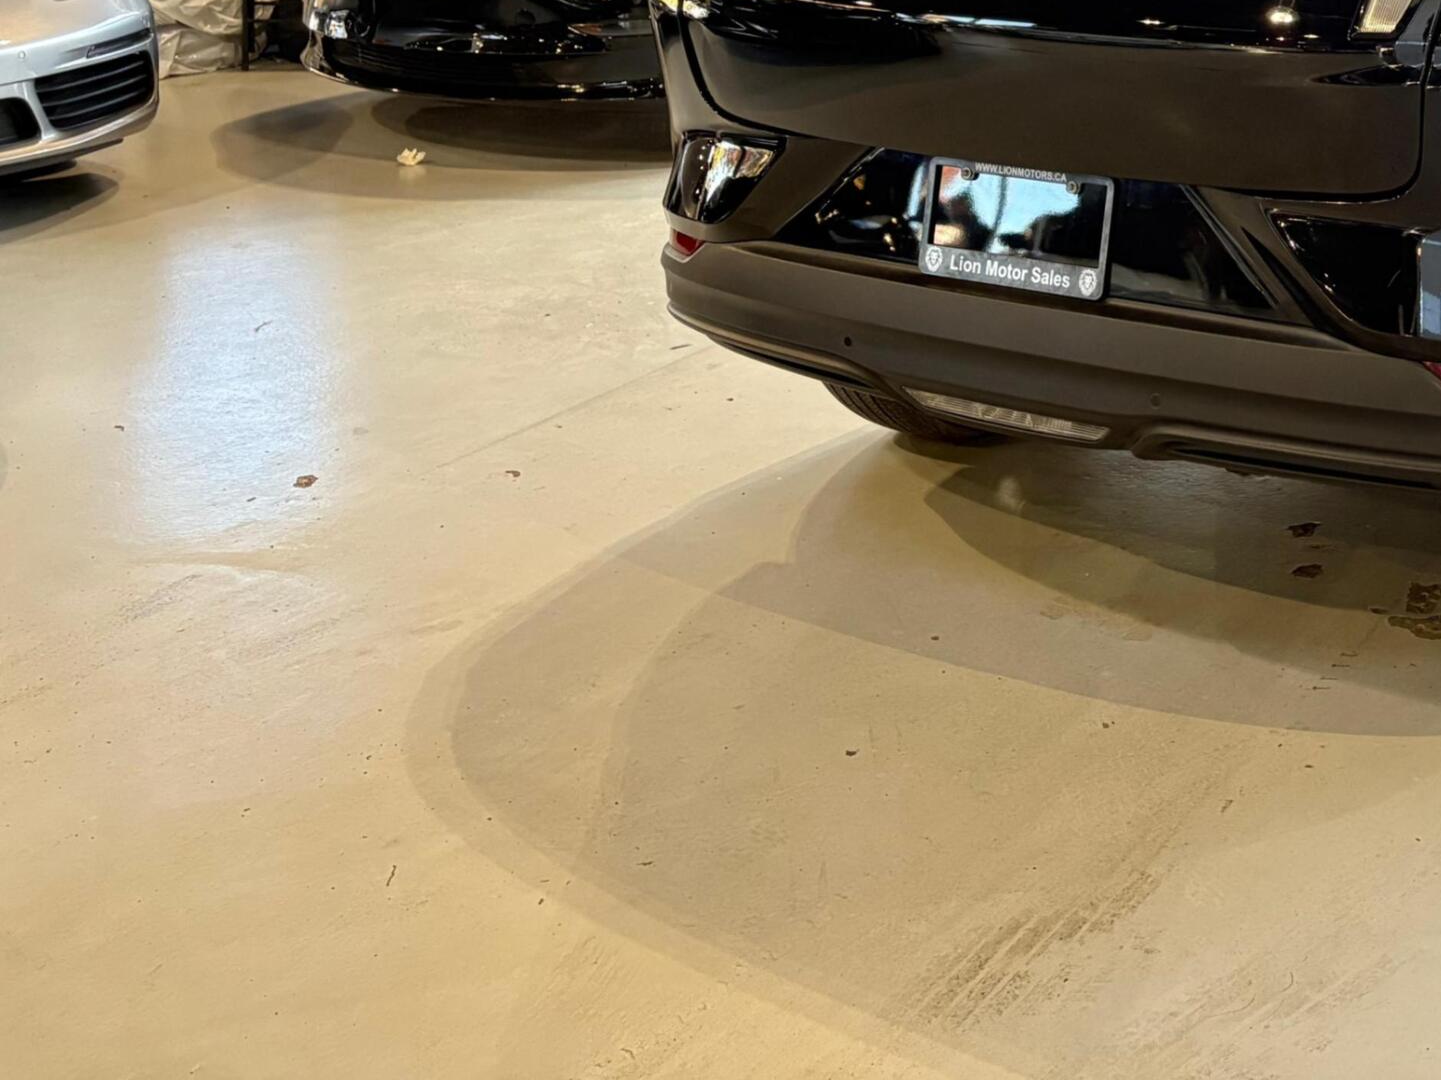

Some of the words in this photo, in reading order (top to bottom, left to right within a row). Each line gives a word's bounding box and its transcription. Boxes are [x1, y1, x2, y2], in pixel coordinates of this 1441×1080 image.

[975, 162, 1067, 182] WWW.LIONMOTORS.CA
[950, 254, 981, 274] Lion
[985, 260, 1029, 281] Motor
[1031, 267, 1071, 289] Sales
